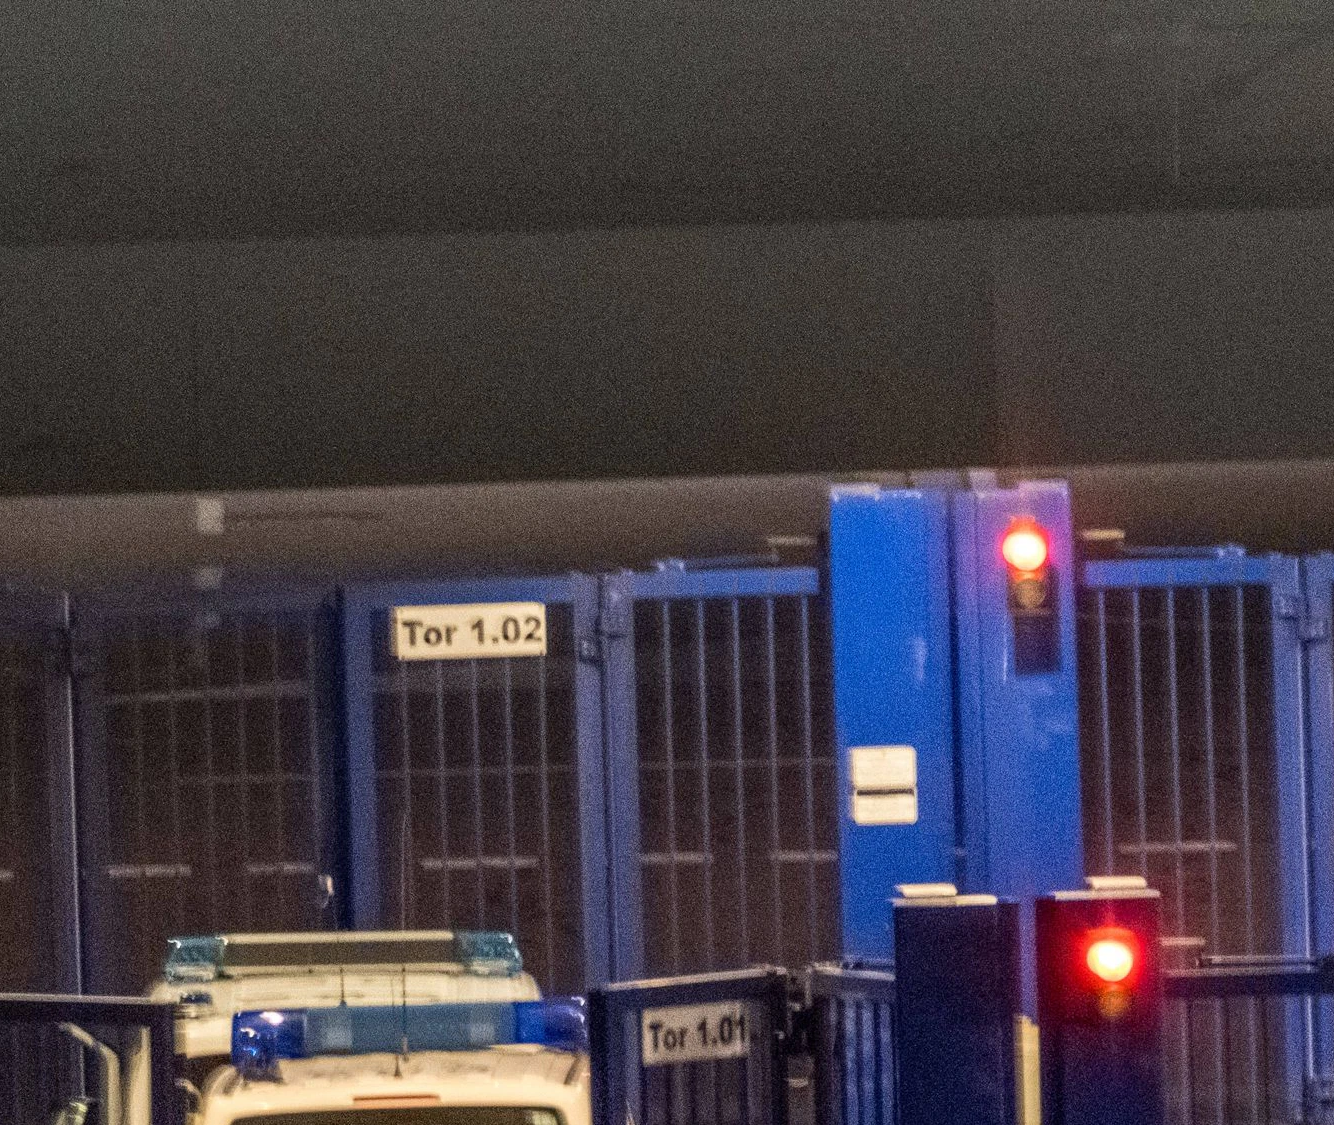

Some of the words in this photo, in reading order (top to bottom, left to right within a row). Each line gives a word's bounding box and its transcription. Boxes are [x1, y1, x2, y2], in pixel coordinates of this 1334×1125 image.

[401, 619, 457, 647] Tor
[471, 615, 543, 645] 1.02
[649, 1021, 688, 1053] Tor
[697, 1014, 746, 1047] 1.01
